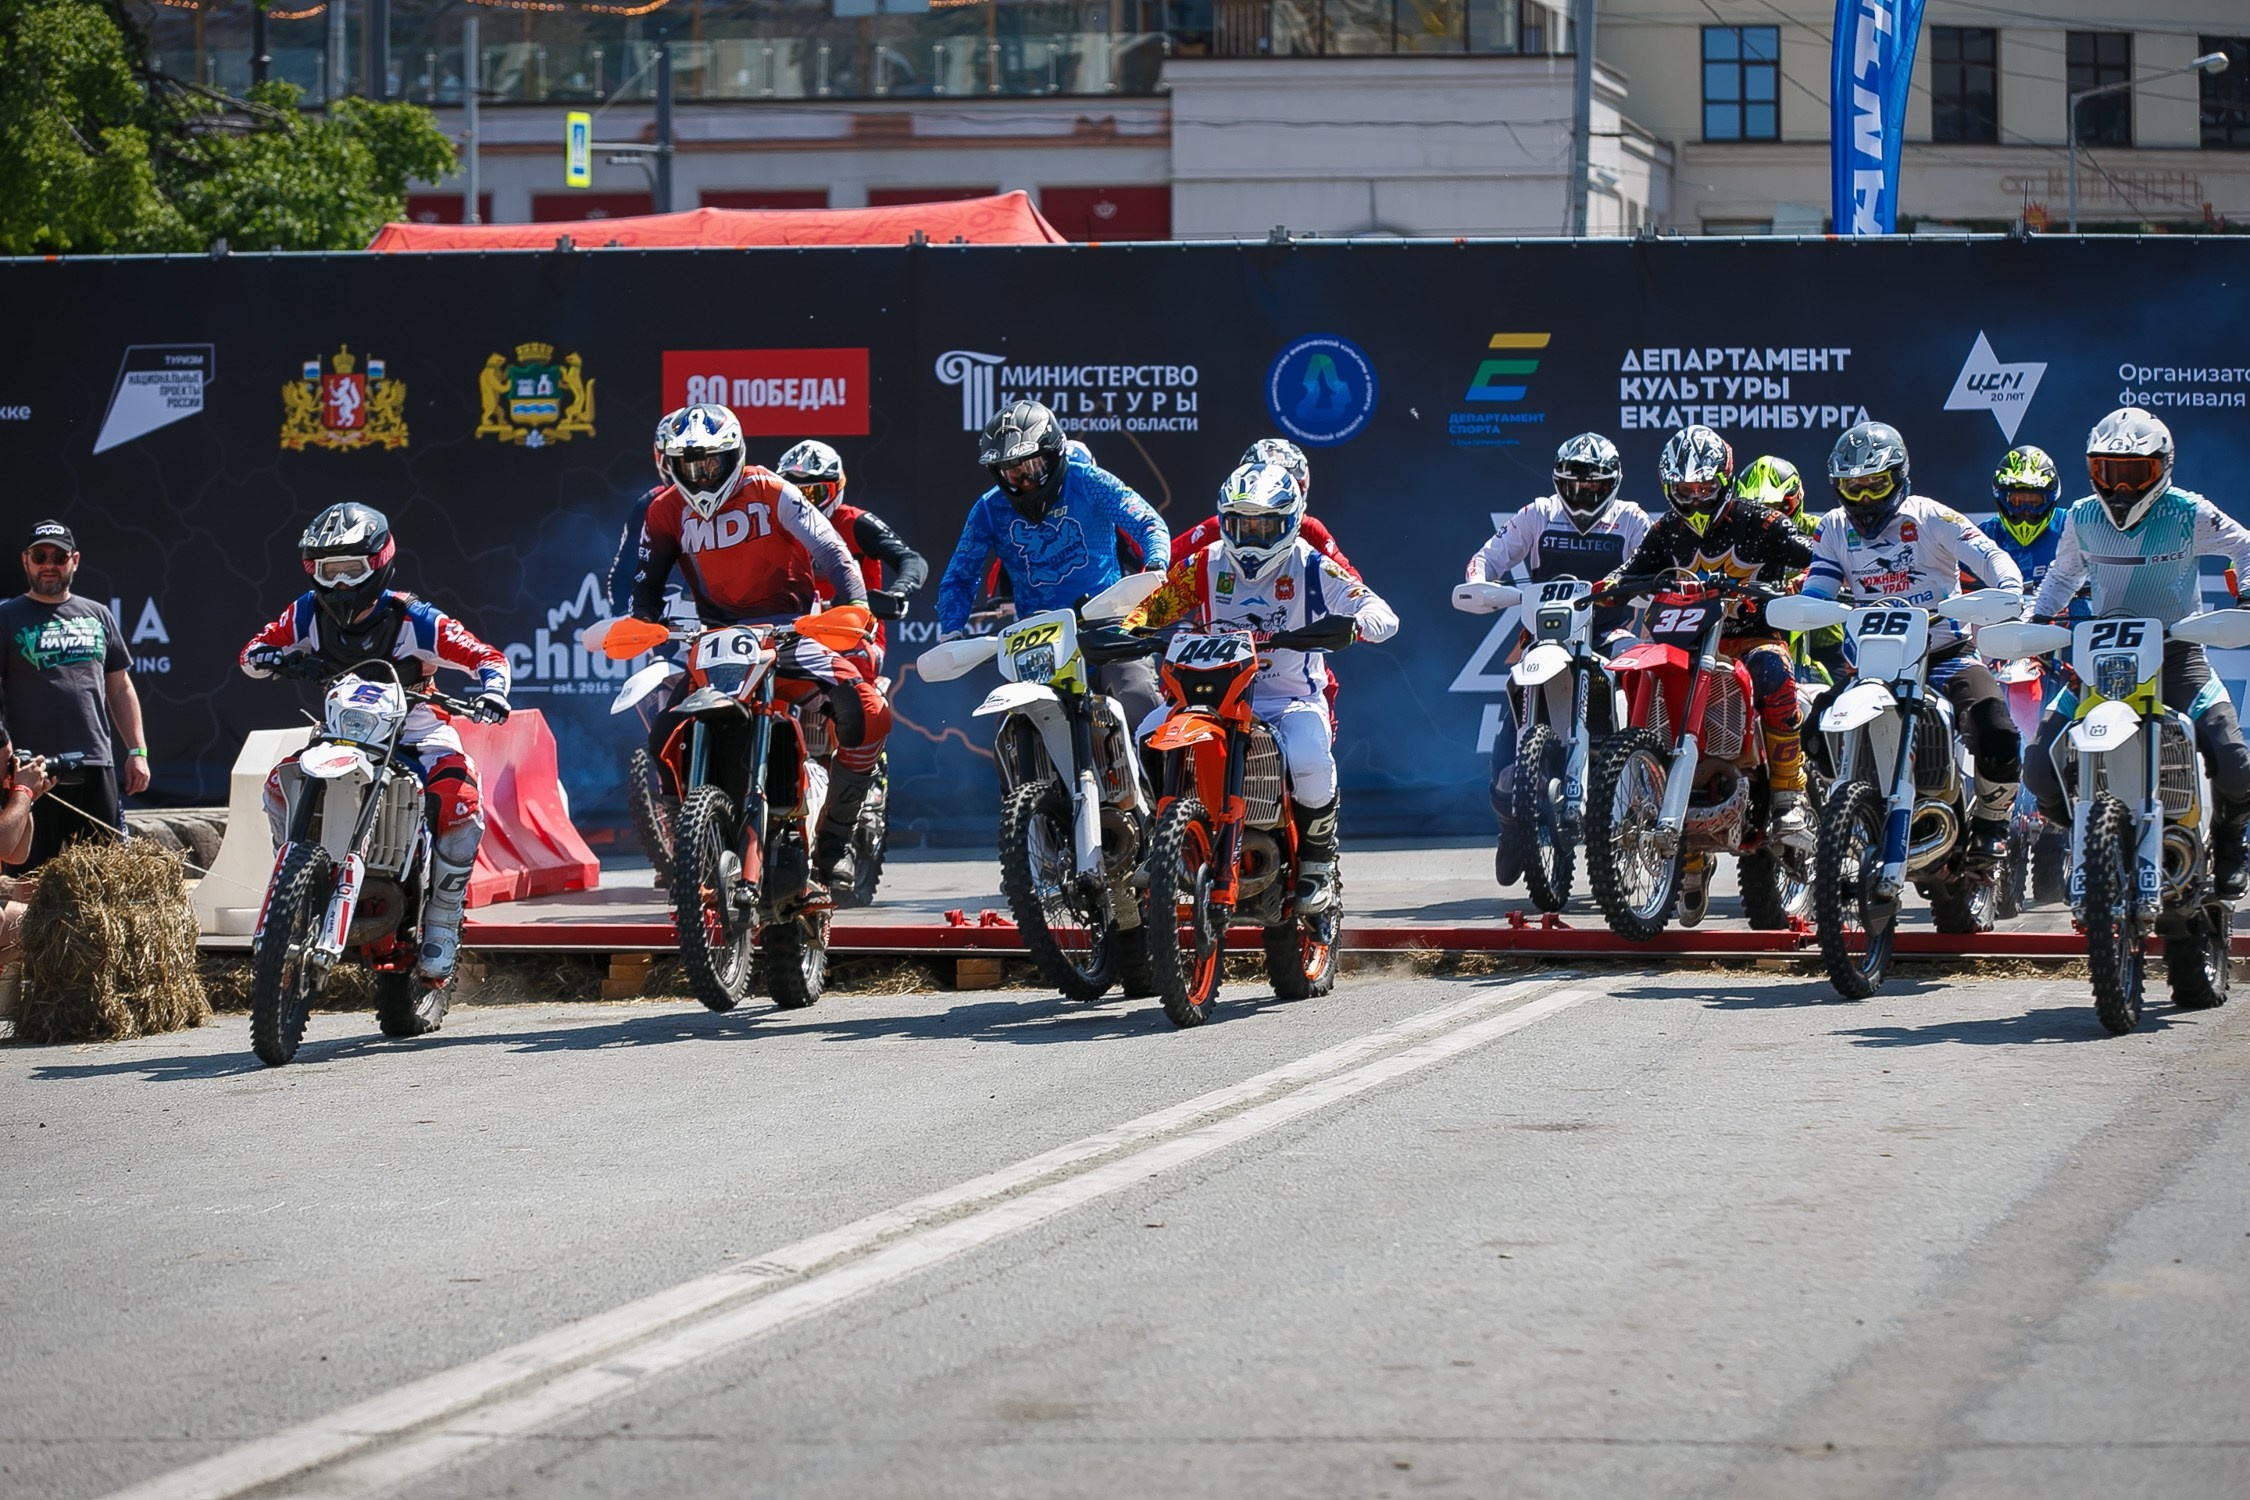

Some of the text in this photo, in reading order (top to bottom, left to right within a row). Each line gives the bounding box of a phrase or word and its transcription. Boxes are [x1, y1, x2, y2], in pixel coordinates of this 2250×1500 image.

[1620, 347, 1852, 372] ДЕПАРТАМЕНТ
[1000, 365, 1199, 387] МИНИСТЕРСТВО
[686, 375, 847, 410] 80 ПОБЕДА!
[1620, 376, 1791, 401] КУЛЬТУРЫ
[2118, 387, 2247, 407] фестиваля
[1056, 414, 1198, 432] ОВСКОЙ ОБЛАСТИ
[1449, 412, 1546, 424] ДЕПАРТАМЕНТ
[1620, 405, 1871, 429] ЕКАТЕРИНБУРГА
[1448, 424, 1501, 434] СПОРТА
[1542, 536, 1620, 551] STELLTECH
[1863, 568, 1908, 586] ЮЖНЫЙ
[1883, 580, 1910, 594] УРАЛ
[1539, 583, 1575, 602] 80
[1653, 609, 1706, 632] 32
[1858, 611, 1912, 636] 86
[704, 634, 753, 659] 16
[2089, 622, 2146, 652] 26
[552, 682, 610, 694] est. 2016
